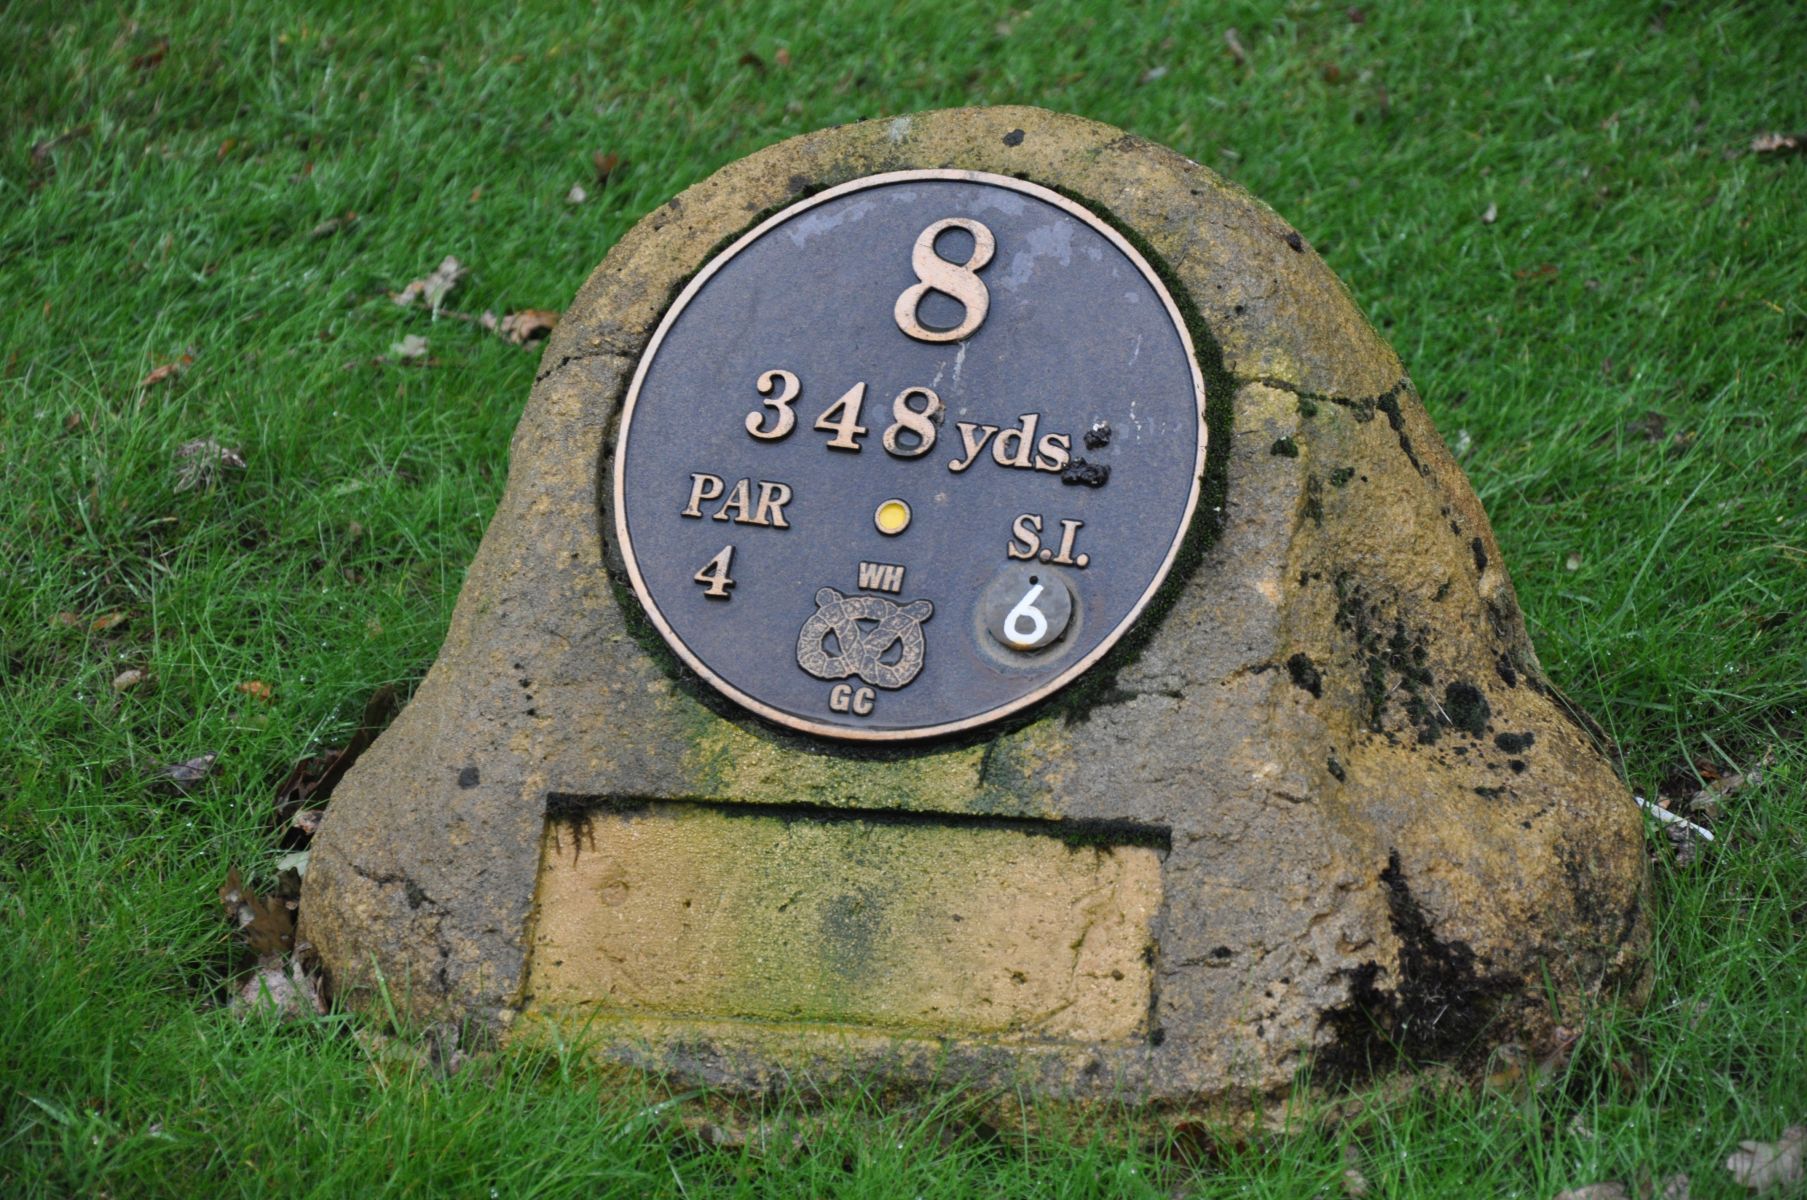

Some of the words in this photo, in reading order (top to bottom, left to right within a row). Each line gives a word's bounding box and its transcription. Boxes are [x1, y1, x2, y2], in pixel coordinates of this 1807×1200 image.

[894, 217, 996, 342] 8
[745, 369, 941, 457] 348
[681, 473, 793, 528] PAR
[1007, 513, 1090, 568] S.I.
[694, 545, 736, 599] 4
[858, 561, 905, 593] WH
[1003, 585, 1048, 644] 6
[829, 684, 876, 715] GC
